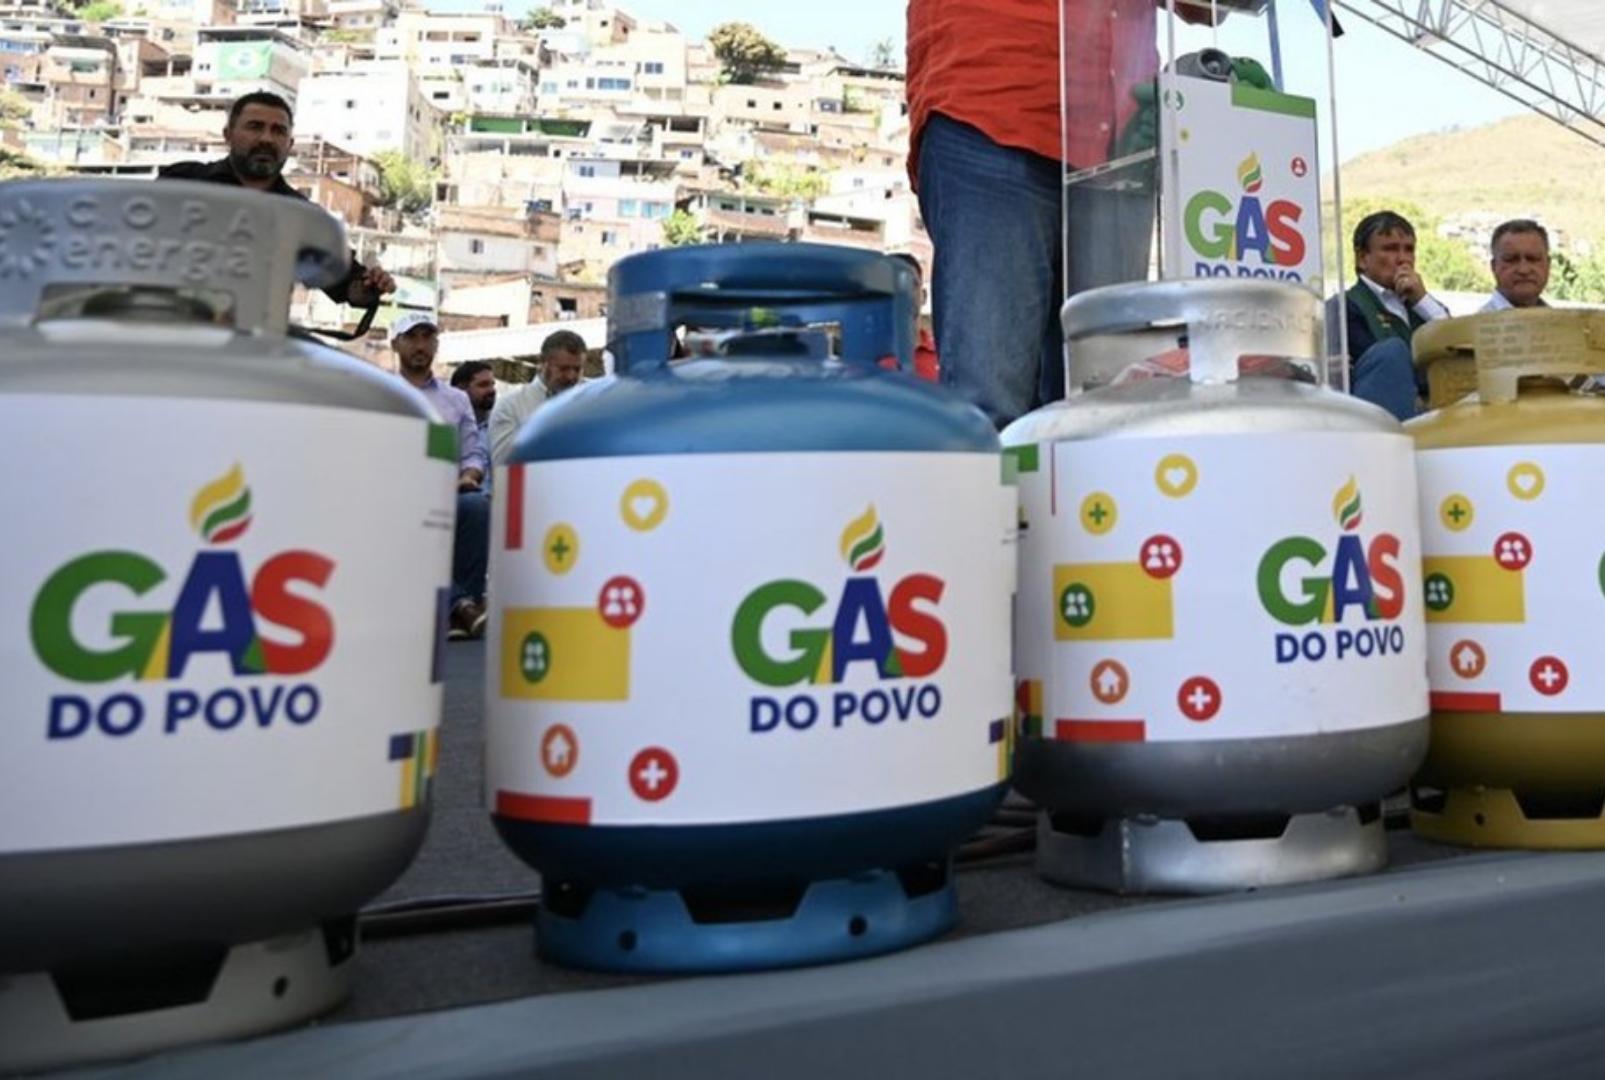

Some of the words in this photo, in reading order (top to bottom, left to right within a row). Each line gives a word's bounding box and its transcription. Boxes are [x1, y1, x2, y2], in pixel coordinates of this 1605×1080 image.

[66, 195, 255, 241] COPA
[61, 235, 253, 283] energia
[1275, 632, 1327, 664] DO
[1335, 624, 1405, 660] POVO
[46, 692, 145, 741] DO
[163, 683, 322, 735] POVO
[750, 694, 819, 734] DO
[833, 684, 942, 728] POVO
